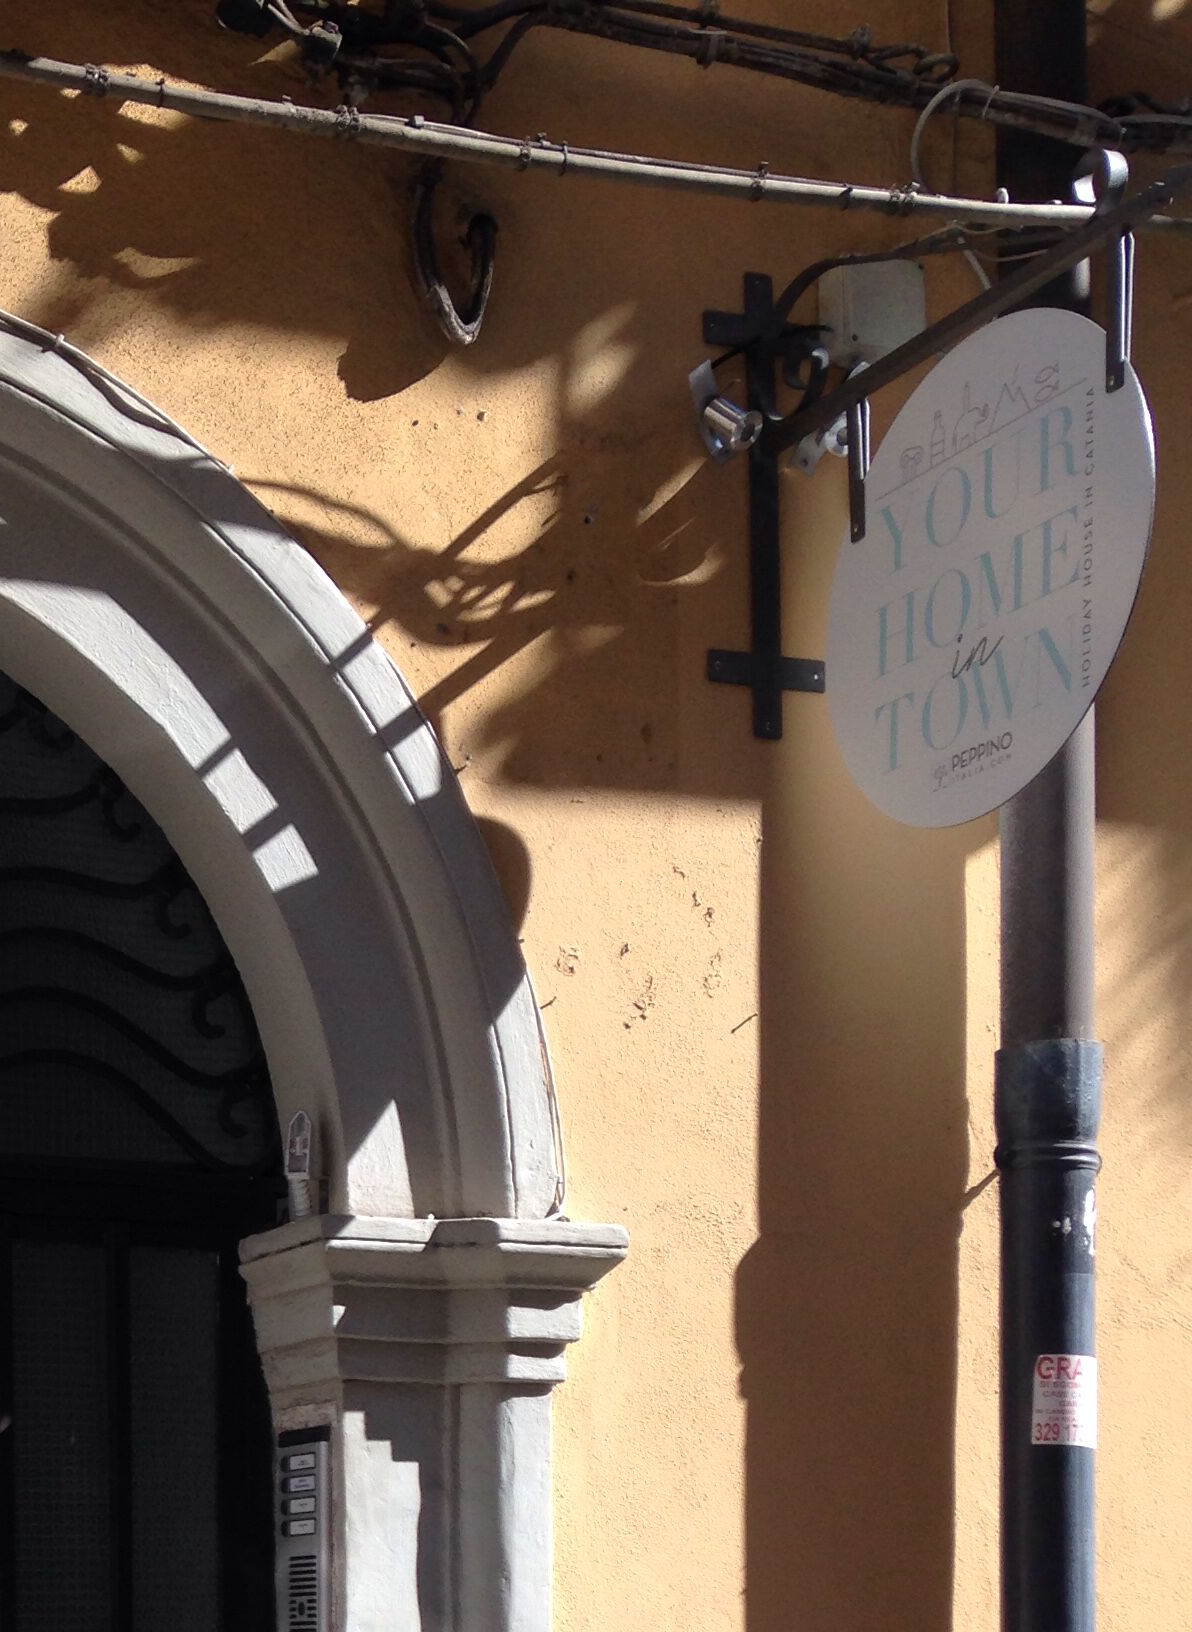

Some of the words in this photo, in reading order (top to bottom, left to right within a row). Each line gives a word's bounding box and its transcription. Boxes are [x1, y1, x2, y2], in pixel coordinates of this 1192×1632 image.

[1084, 387, 1095, 477] CATANIA
[874, 405, 1080, 577] YOUR
[1084, 486, 1094, 507] IN
[873, 504, 1081, 681] HOME
[1083, 516, 1094, 588] HOUSE
[951, 633, 1005, 679] in
[1081, 599, 1093, 689] HOLIDAY
[874, 613, 1077, 776] TOWN
[951, 731, 1013, 773] PEPPINO
